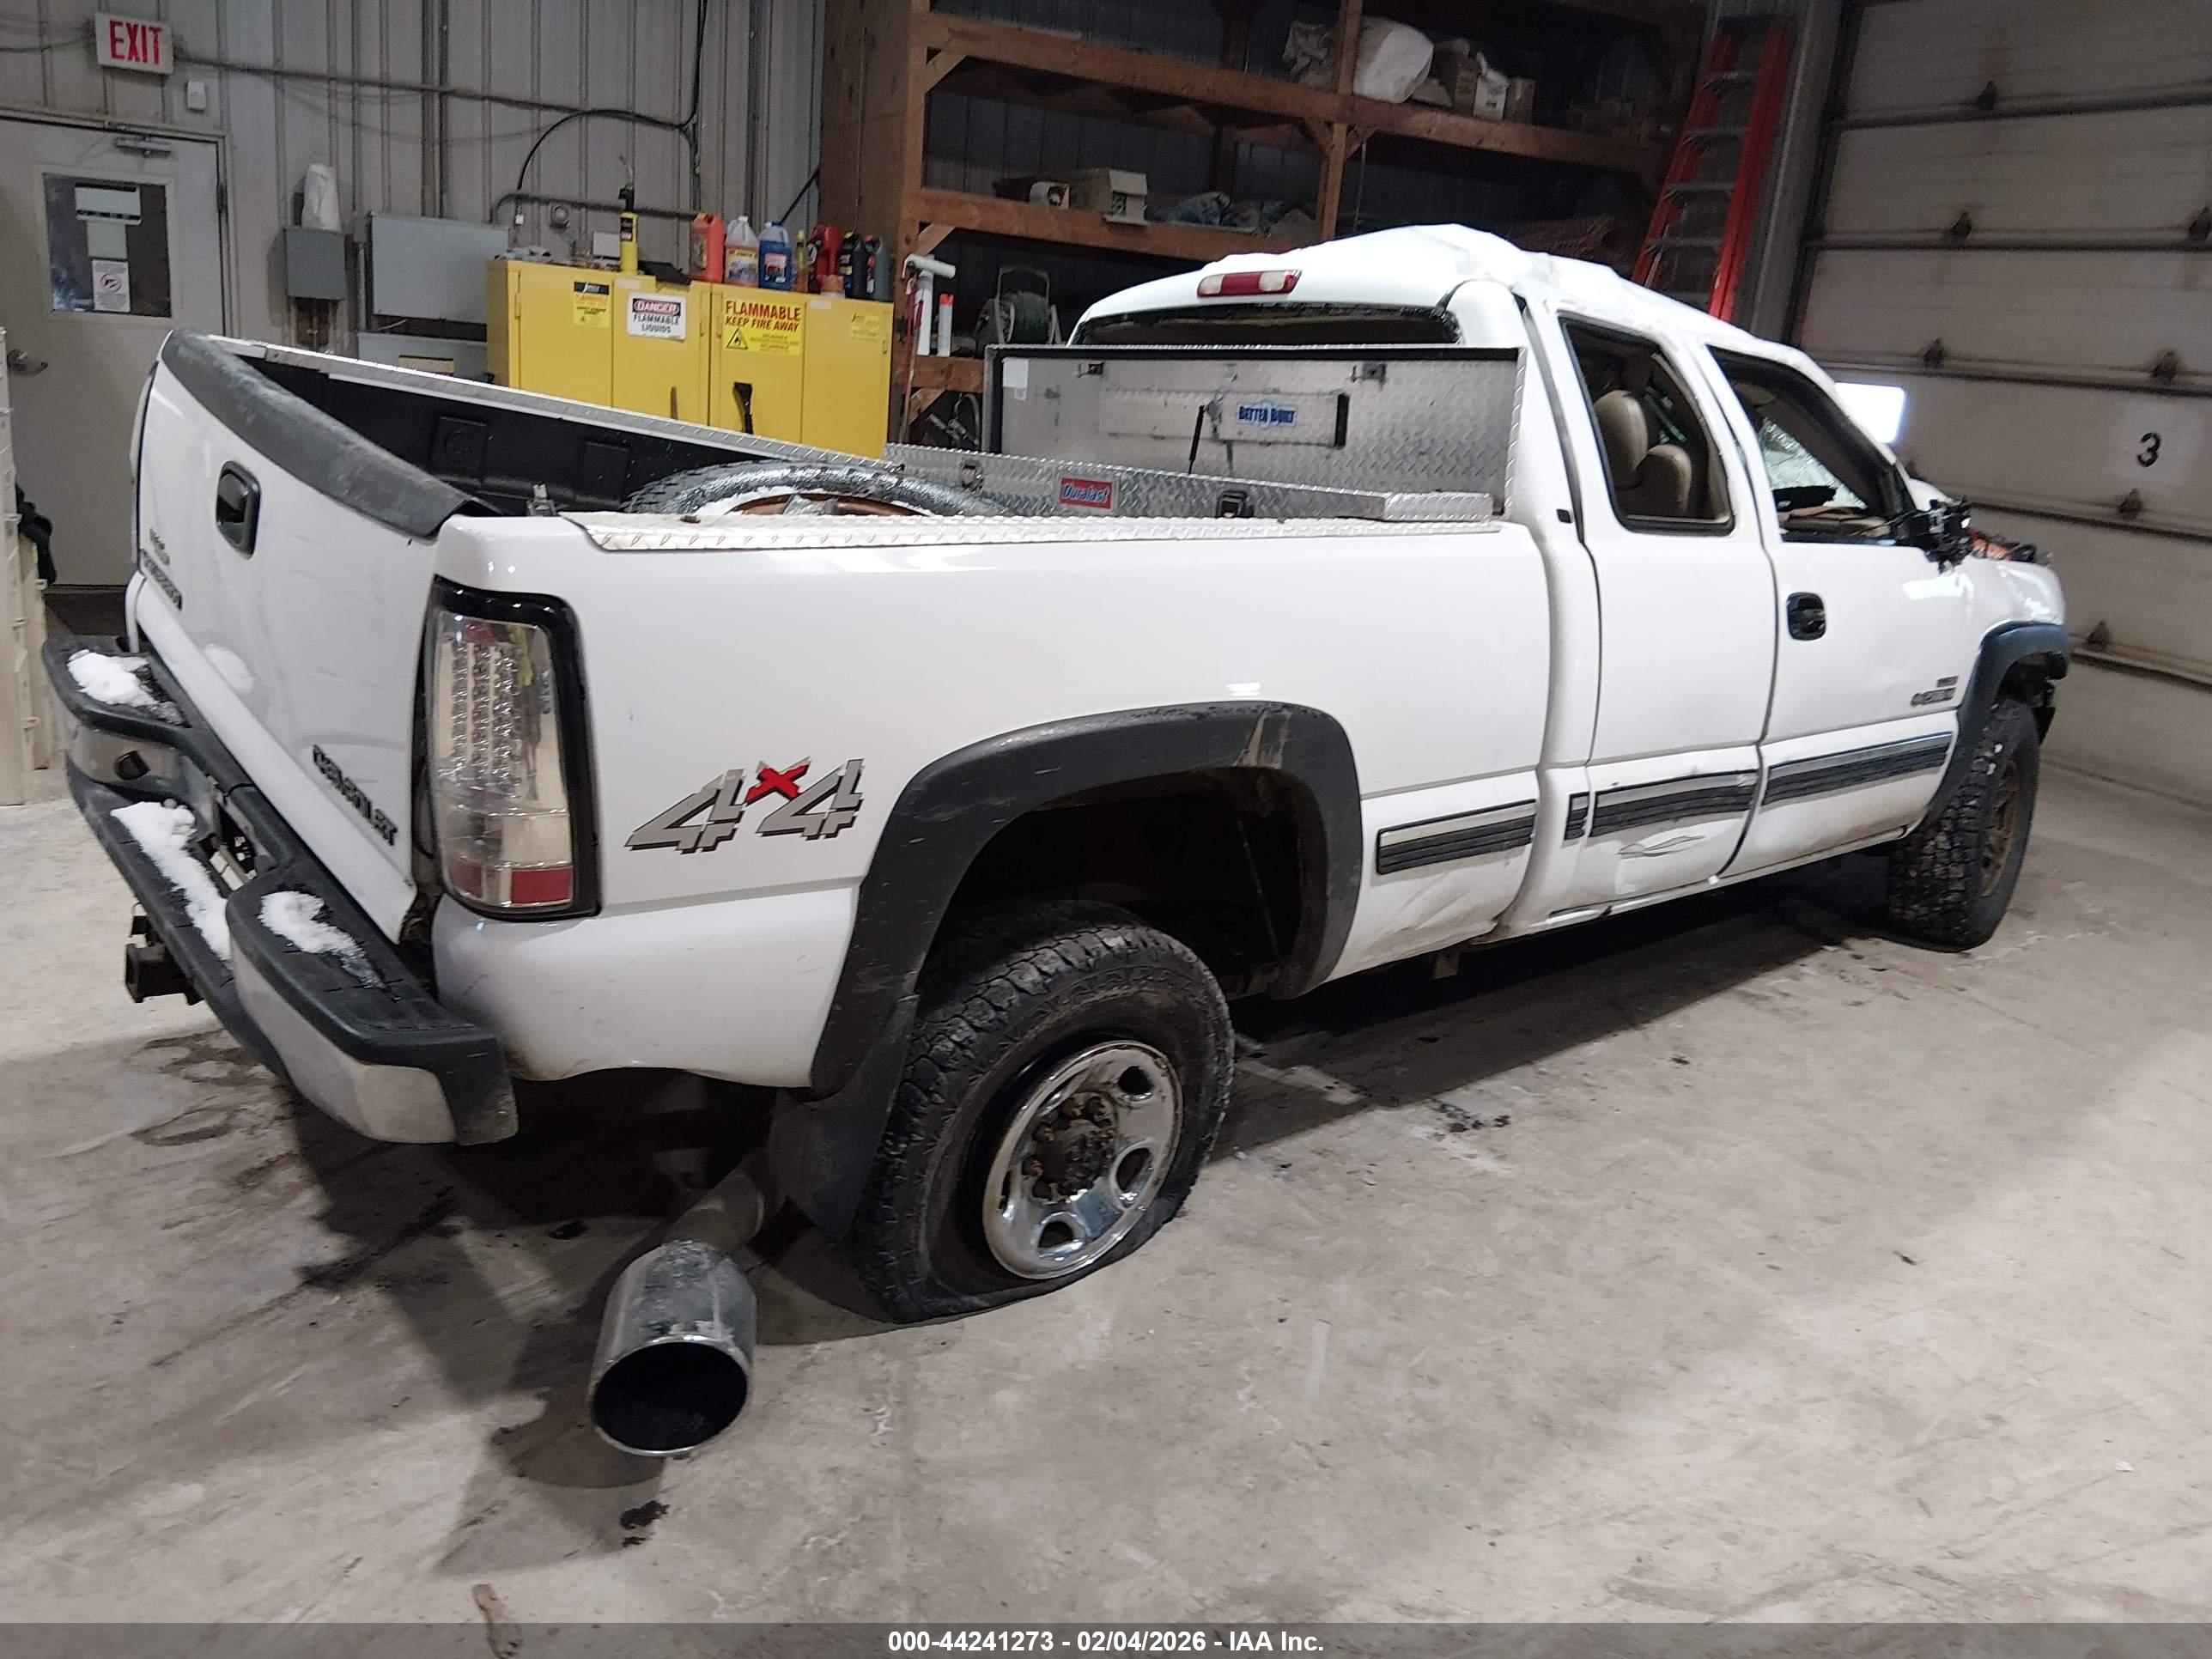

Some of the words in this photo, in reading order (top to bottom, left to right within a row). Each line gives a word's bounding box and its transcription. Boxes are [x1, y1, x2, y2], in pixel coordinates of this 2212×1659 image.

[110, 20, 161, 64] EXIT
[635, 301, 678, 314] DANGER
[726, 301, 801, 320] FLAMMABLE
[725, 315, 749, 327] KEEP
[750, 319, 771, 330] FIRE
[773, 321, 799, 332] AWAY
[2136, 432, 2161, 467] 3
[1062, 483, 1109, 503] Duralast
